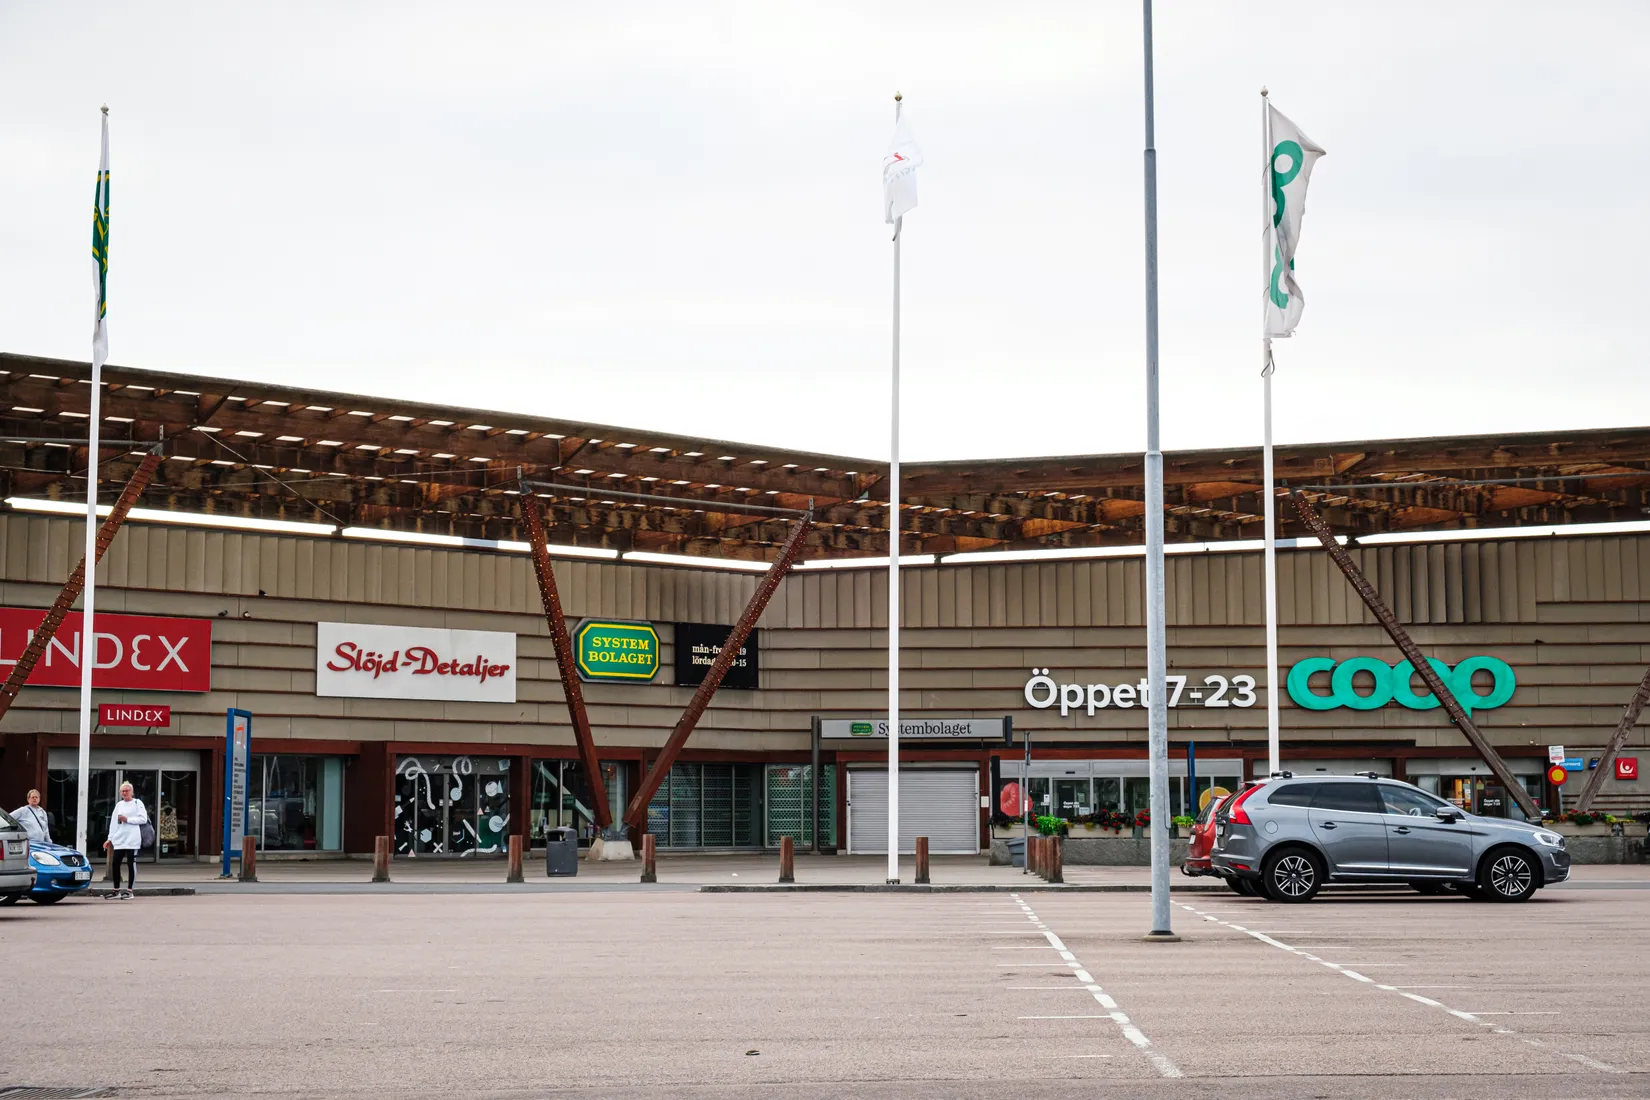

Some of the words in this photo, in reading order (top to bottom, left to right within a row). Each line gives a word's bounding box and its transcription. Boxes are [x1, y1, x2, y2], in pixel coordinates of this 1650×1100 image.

[592, 636, 650, 650] SYSTEM
[326, 641, 510, 684] Slöjd-Detaljer
[588, 651, 653, 665] BOLAGET
[1024, 668, 1149, 716] Öppet
[1165, 674, 1257, 708] 7-23
[1287, 656, 1516, 724] coop
[106, 709, 163, 722] LINDEX
[878, 721, 972, 737] Sytembolaget
